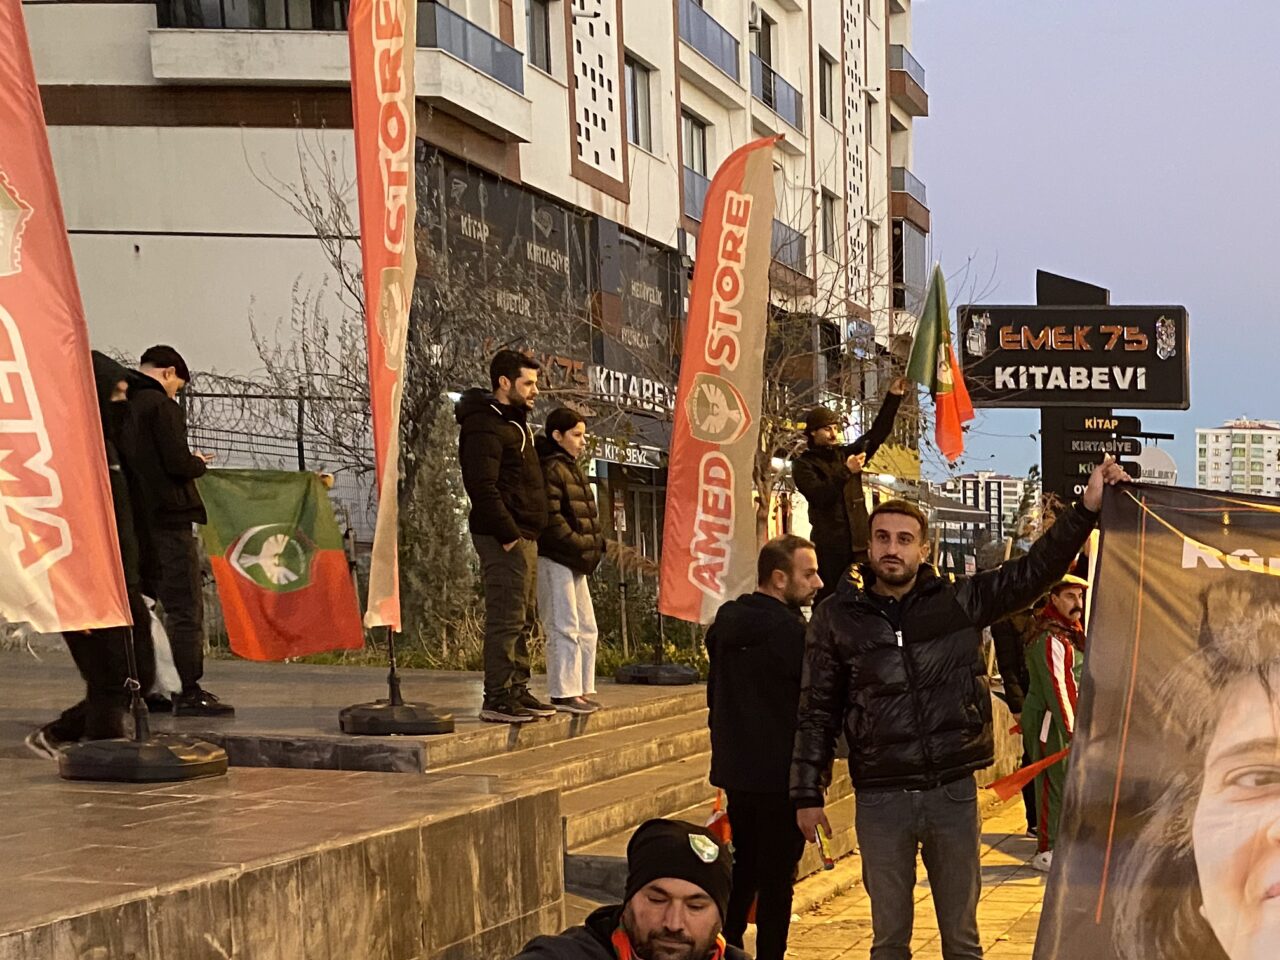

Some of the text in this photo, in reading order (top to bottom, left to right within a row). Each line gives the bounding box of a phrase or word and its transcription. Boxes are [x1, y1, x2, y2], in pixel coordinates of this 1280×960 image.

[372, 0, 411, 254] STORE
[705, 190, 753, 371] STORE
[999, 325, 1149, 351] EMEK 75
[1085, 416, 1119, 429] KİTAP
[688, 451, 735, 600] AMED
